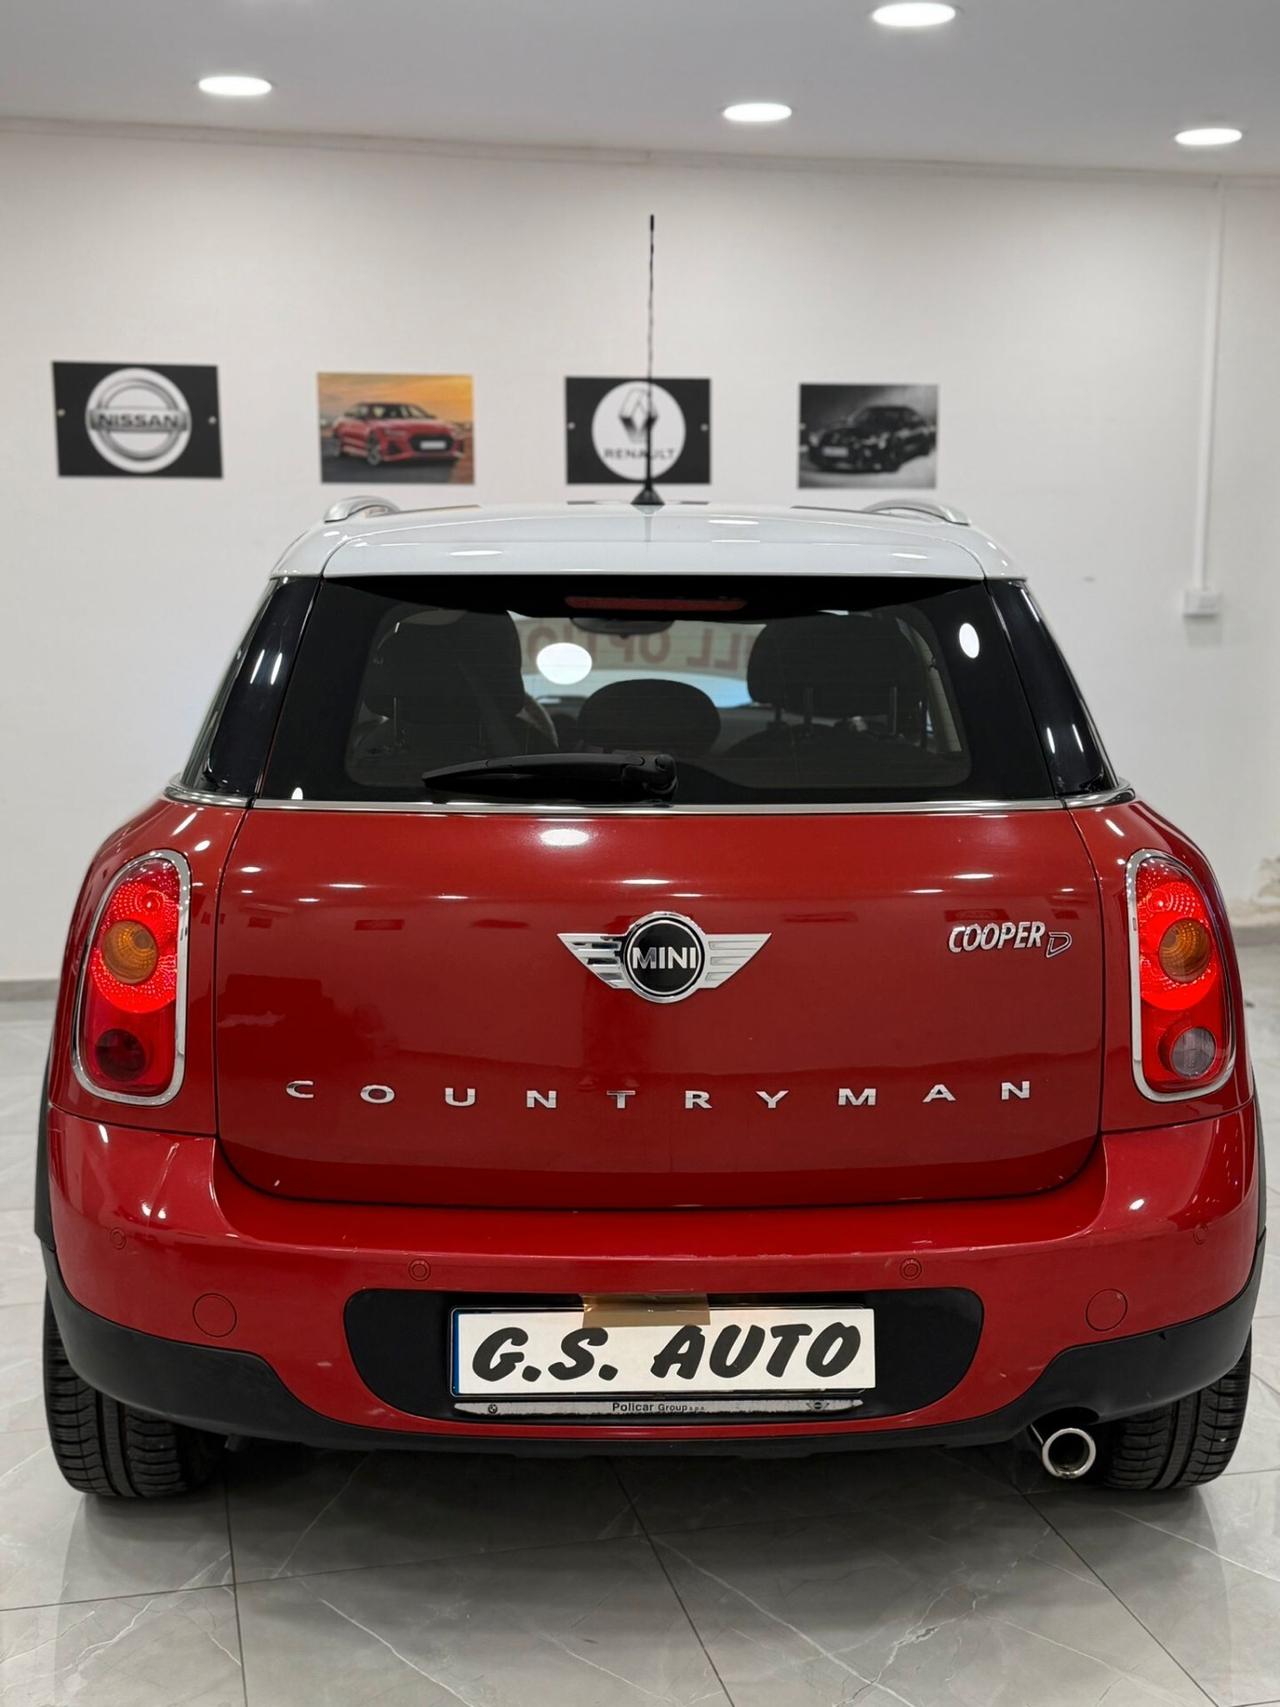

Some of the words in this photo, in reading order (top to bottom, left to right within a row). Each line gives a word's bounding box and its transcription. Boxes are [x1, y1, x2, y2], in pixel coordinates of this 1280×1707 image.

[98, 413, 178, 428] NISSAN
[948, 921, 1046, 953] COOPER
[1045, 931, 1073, 958] D
[632, 946, 697, 969] MINI
[286, 1080, 1030, 1109] COUNTRYMAN
[472, 1326, 618, 1382] G.S.
[650, 1322, 861, 1380] AUTO
[612, 1402, 655, 1412] Policar
[657, 1403, 688, 1413] Group
